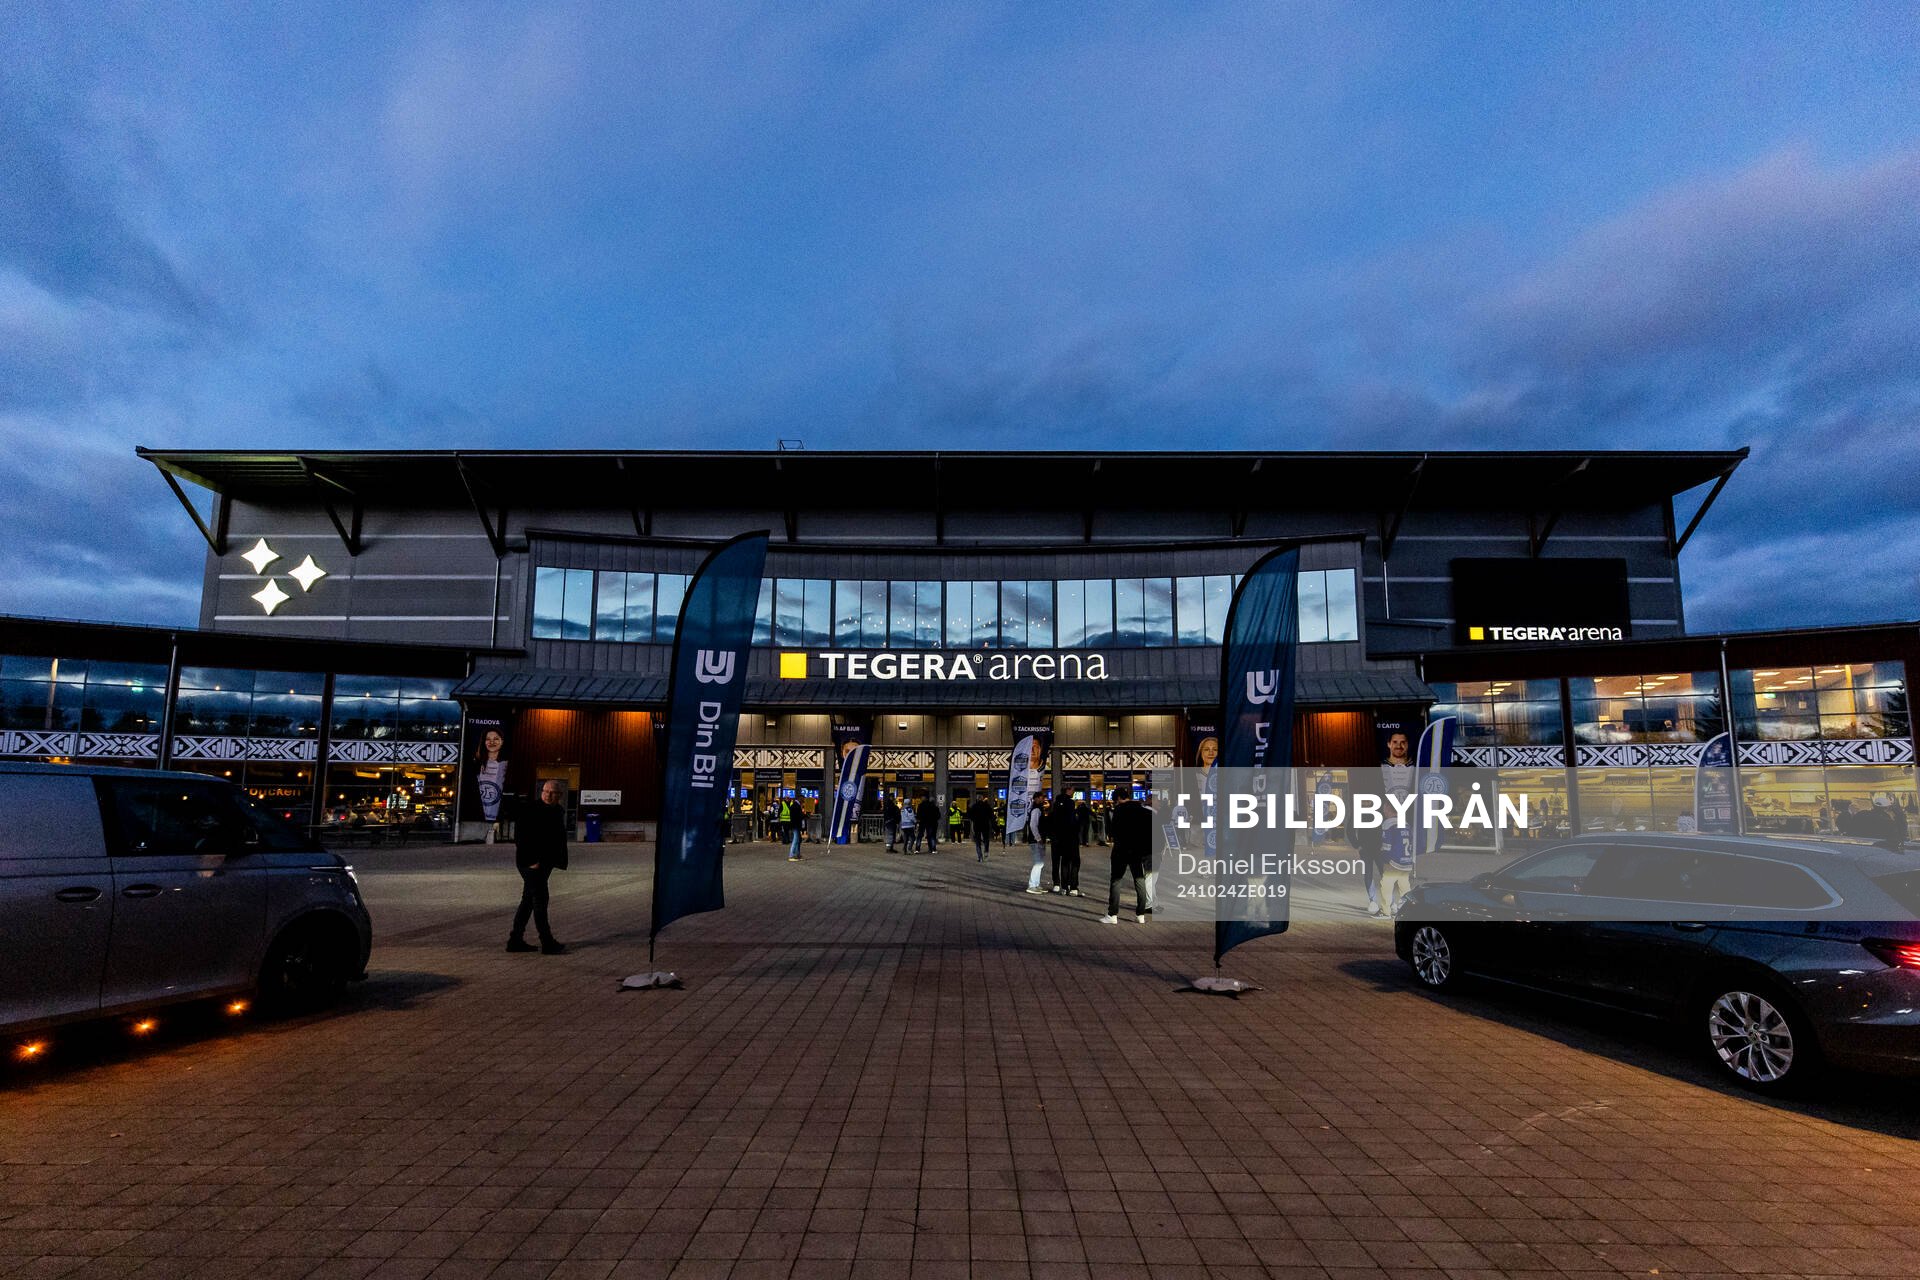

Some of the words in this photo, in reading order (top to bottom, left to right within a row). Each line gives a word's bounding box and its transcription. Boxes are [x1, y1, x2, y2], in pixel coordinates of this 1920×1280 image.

[1568, 626, 1623, 641] arena
[989, 653, 1109, 681] arena
[695, 701, 722, 748] Din
[691, 754, 717, 789] Bil
